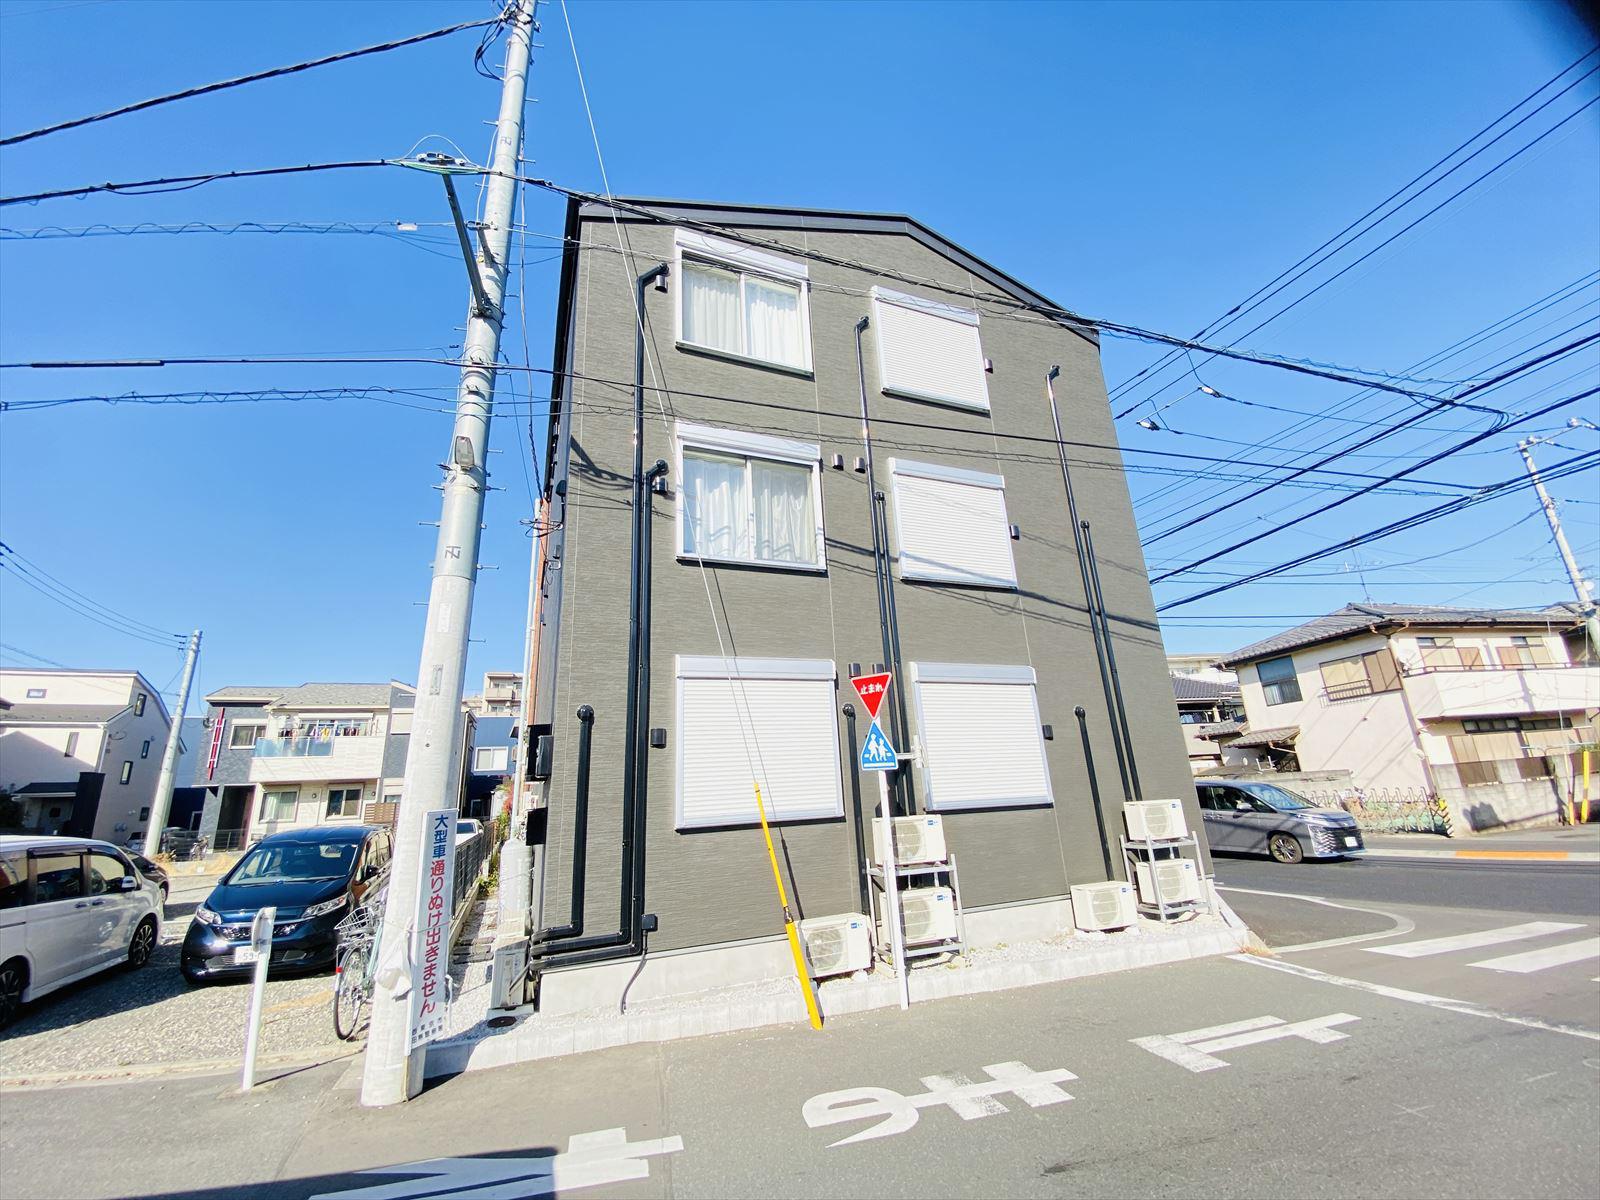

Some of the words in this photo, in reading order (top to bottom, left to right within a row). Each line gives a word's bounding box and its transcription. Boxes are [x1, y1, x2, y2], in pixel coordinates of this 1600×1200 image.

[860, 682, 884, 695] 止まれ
[419, 813, 449, 1018] 大型車通りぬけ出きません
